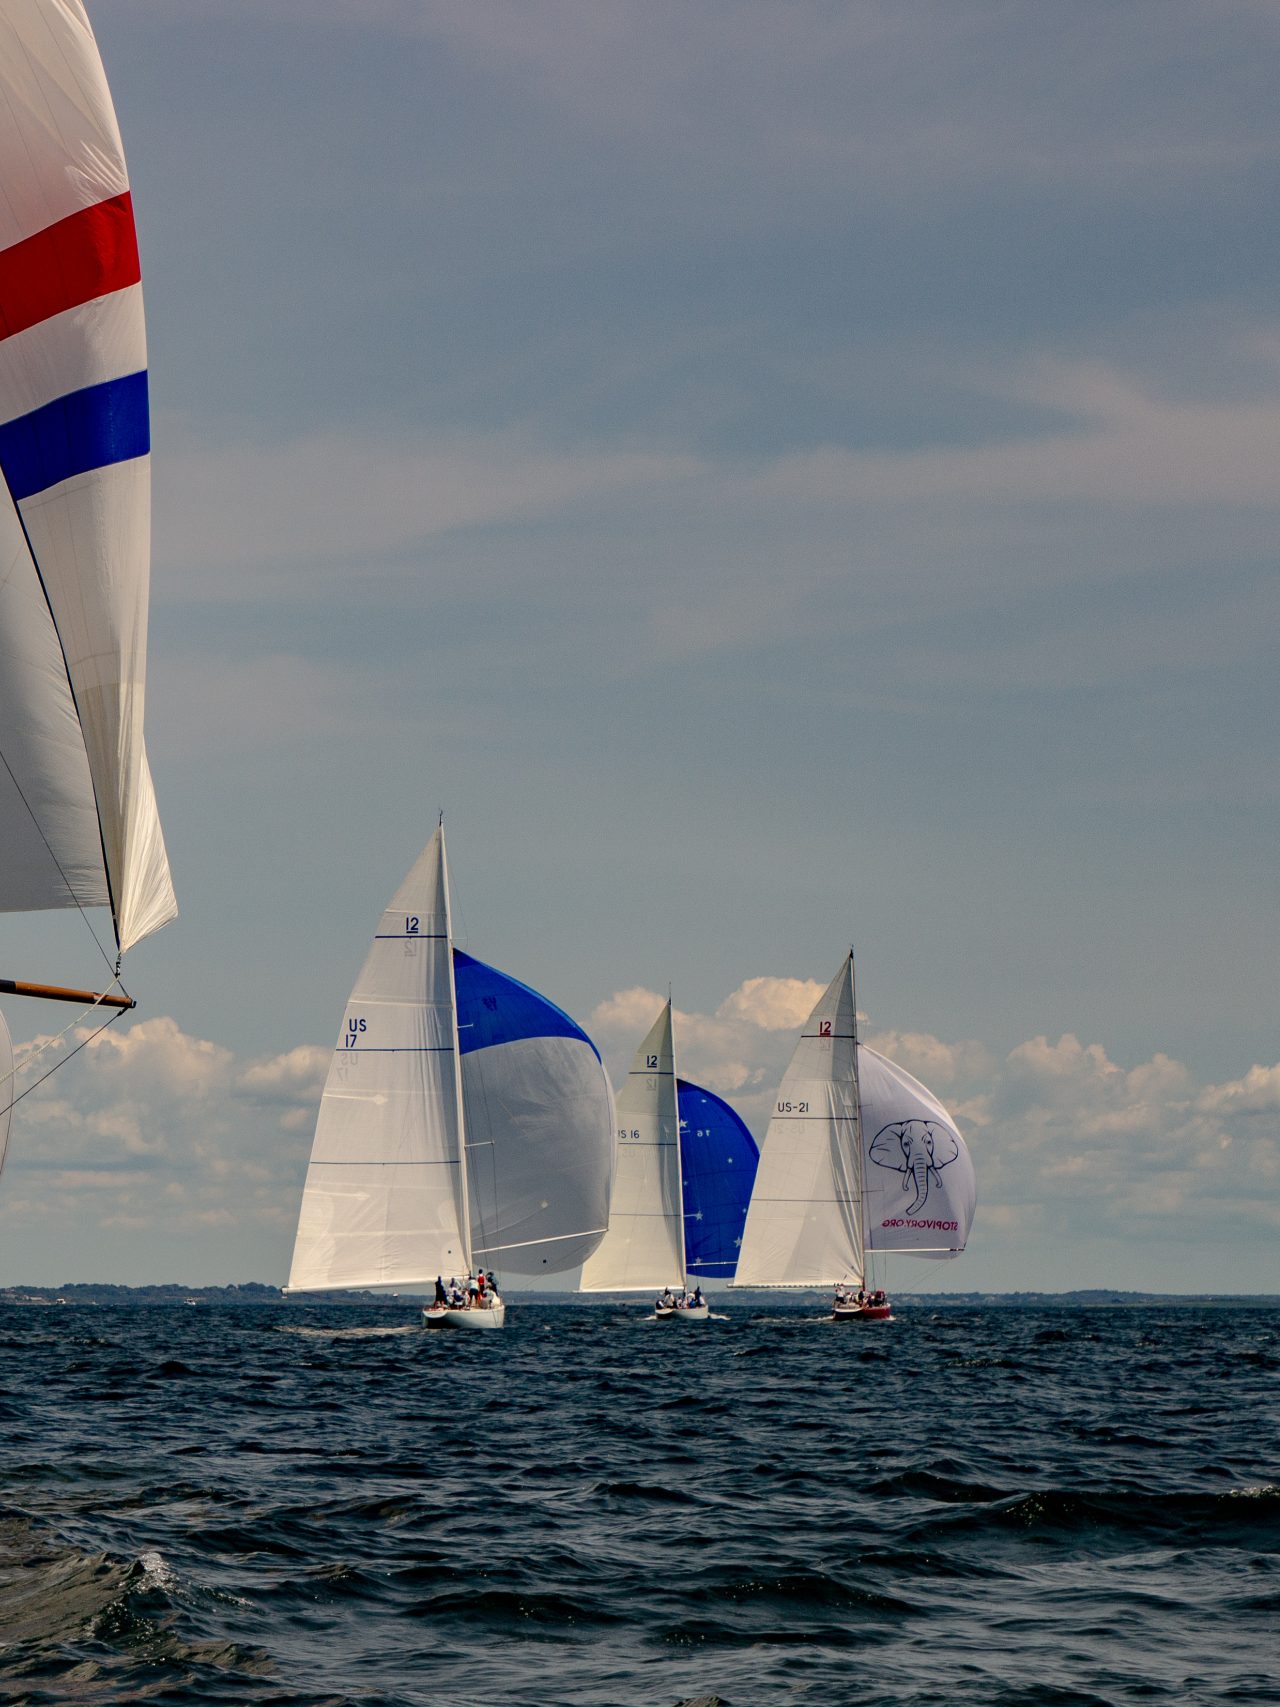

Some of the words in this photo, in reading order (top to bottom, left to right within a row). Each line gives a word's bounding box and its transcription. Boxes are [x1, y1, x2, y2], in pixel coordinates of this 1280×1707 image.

[405, 917, 419, 931] 12
[349, 1018, 367, 1032] US
[819, 1021, 832, 1033] 12
[345, 1034, 357, 1048] 17
[646, 1055, 658, 1066] 12
[777, 1102, 809, 1112] US-21
[630, 1129, 640, 1139] 16
